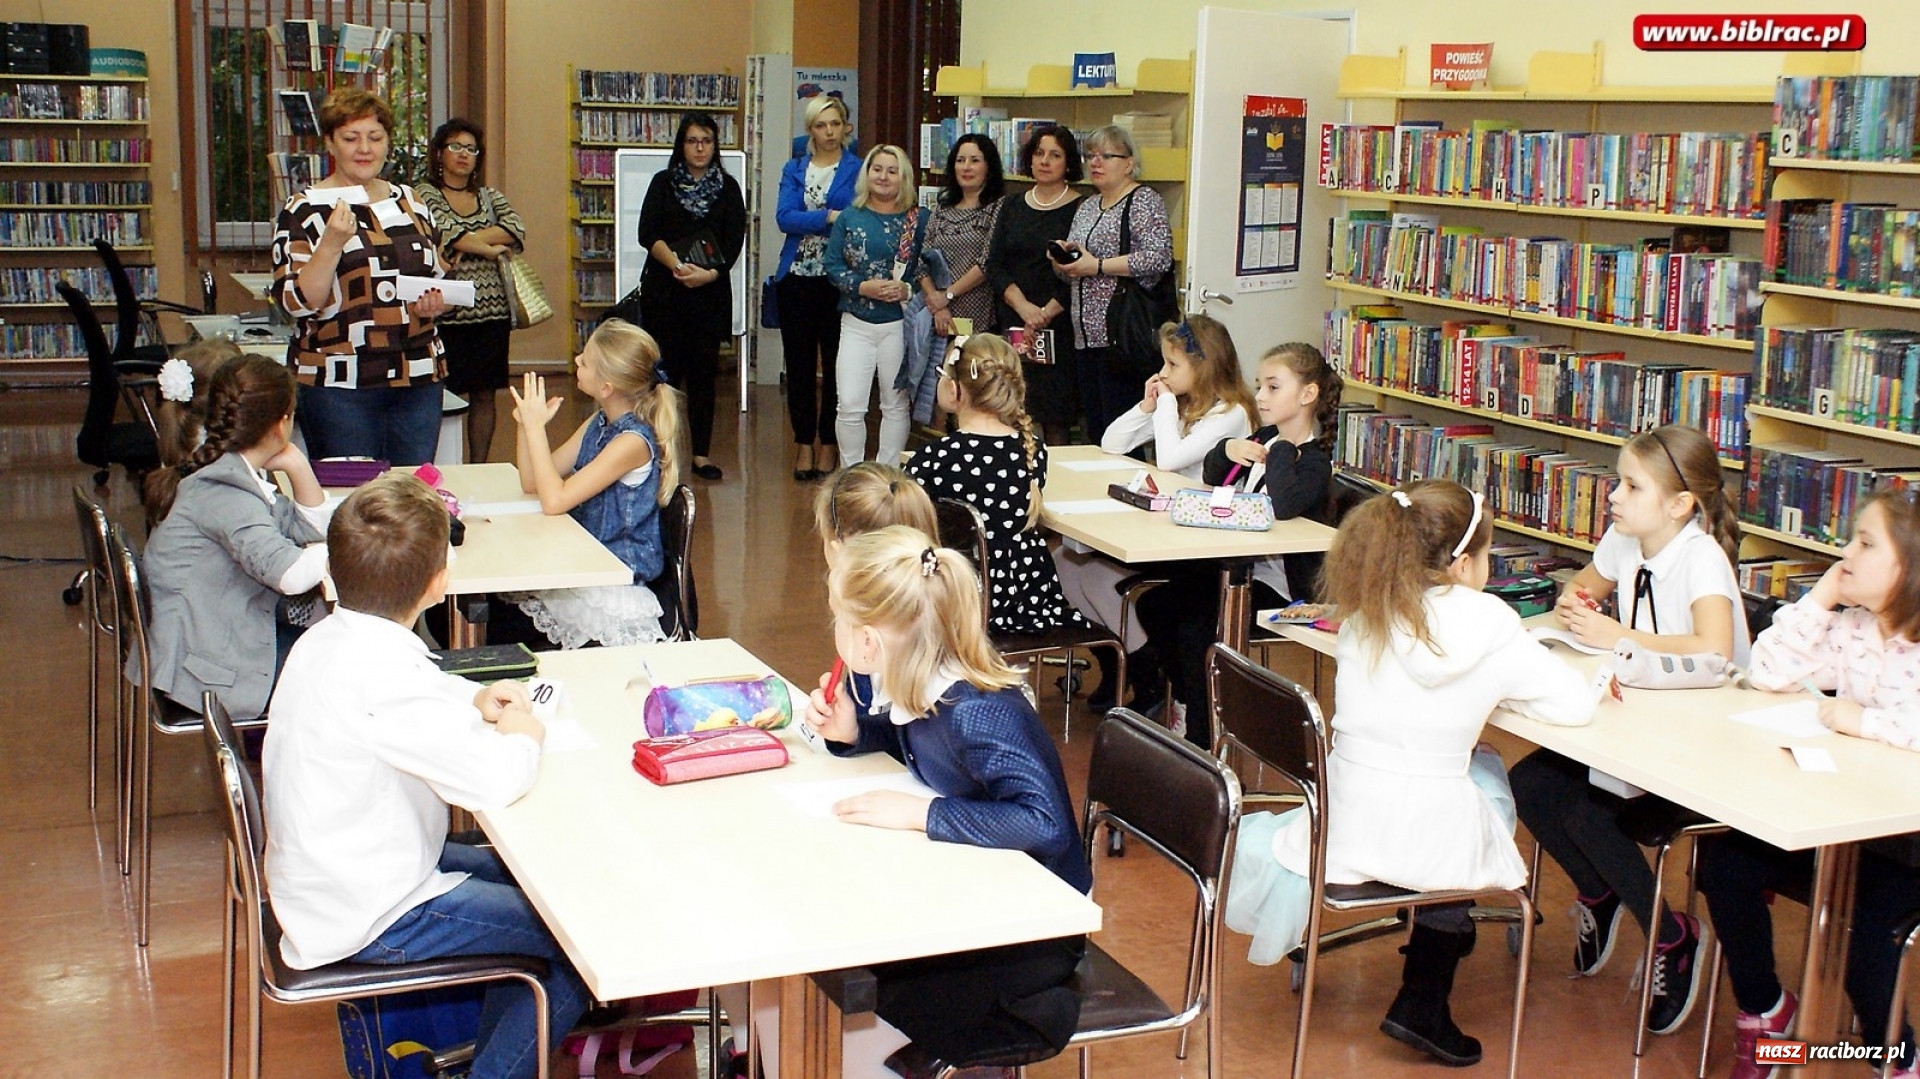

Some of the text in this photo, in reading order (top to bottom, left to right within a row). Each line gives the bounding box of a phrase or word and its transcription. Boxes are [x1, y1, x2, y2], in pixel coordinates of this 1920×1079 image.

[797, 71, 808, 80] Tu
[1323, 127, 1332, 152] LAT
[1782, 133, 1792, 154] C
[1328, 169, 1336, 187] A
[1385, 174, 1393, 191] C
[1494, 182, 1503, 200] H
[1591, 188, 1600, 206] P
[1463, 344, 1472, 402] 12-14 LAT
[1487, 391, 1496, 409] B
[1521, 398, 1530, 416] D
[1819, 394, 1829, 415] G
[531, 683, 554, 705] 10
